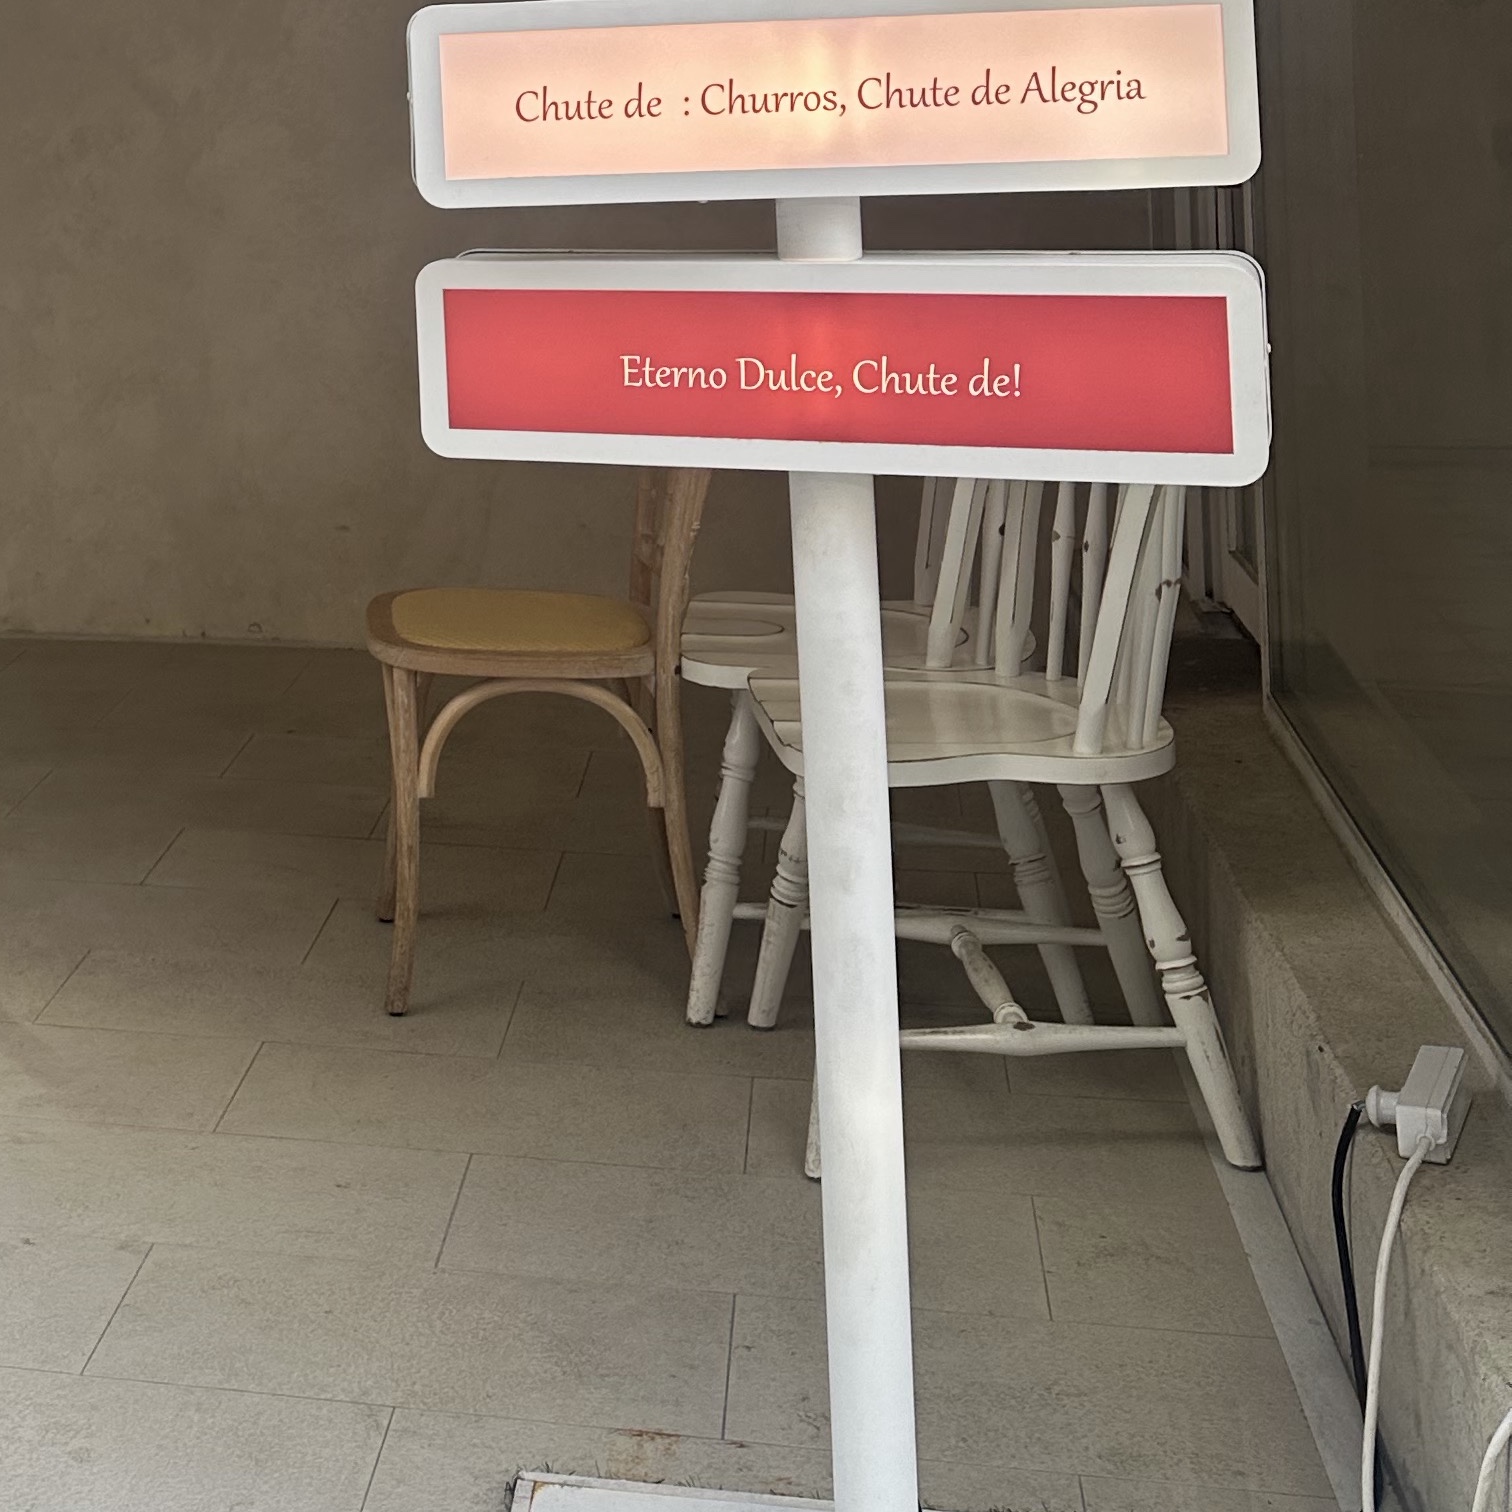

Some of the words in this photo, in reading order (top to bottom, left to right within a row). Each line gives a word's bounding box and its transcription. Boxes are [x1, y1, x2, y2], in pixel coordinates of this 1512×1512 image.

[515, 85, 614, 123] Chute
[623, 81, 662, 119] de
[700, 77, 847, 117] Churros,
[857, 71, 961, 110] Chute
[970, 67, 1011, 106] de
[1019, 65, 1147, 115] Alegria
[619, 355, 727, 390] Eterno
[735, 353, 843, 399] Dulce,
[852, 355, 958, 396] Chute
[968, 357, 1021, 398] de!
